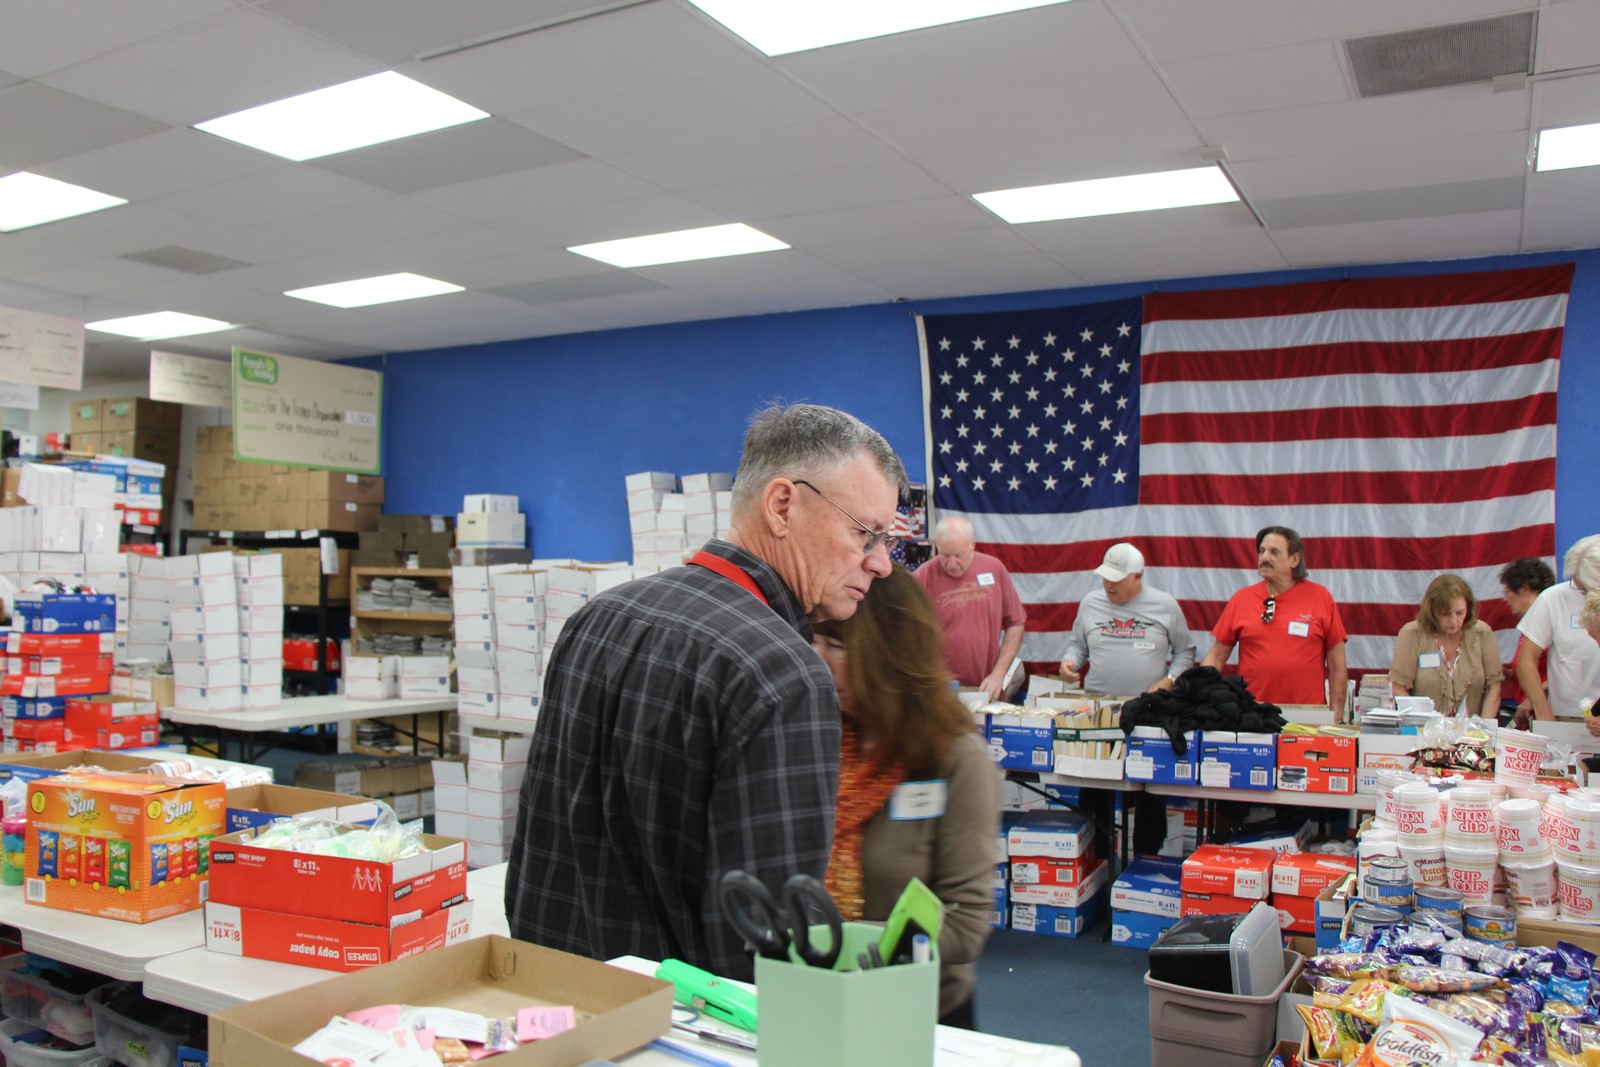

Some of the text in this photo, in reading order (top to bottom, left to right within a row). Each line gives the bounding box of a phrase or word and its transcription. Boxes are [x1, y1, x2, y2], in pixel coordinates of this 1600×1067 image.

[242, 355, 265, 369] fresh
[275, 422, 339, 438] one thousand
[68, 796, 96, 818] Sun
[164, 800, 192, 824] Sun
[80, 811, 99, 824] Chips
[1459, 821, 1488, 833] CUP
[214, 853, 235, 861] STAPLES
[308, 861, 316, 870] 11
[1287, 874, 1293, 882] 11
[1452, 869, 1481, 881] CUP
[394, 884, 412, 899] STAPLES
[214, 927, 223, 938] 11
[222, 929, 230, 938] x
[450, 929, 457, 940] 11
[290, 943, 378, 962] STAPLES copy paper
[1376, 1030, 1442, 1064] Goldfish
